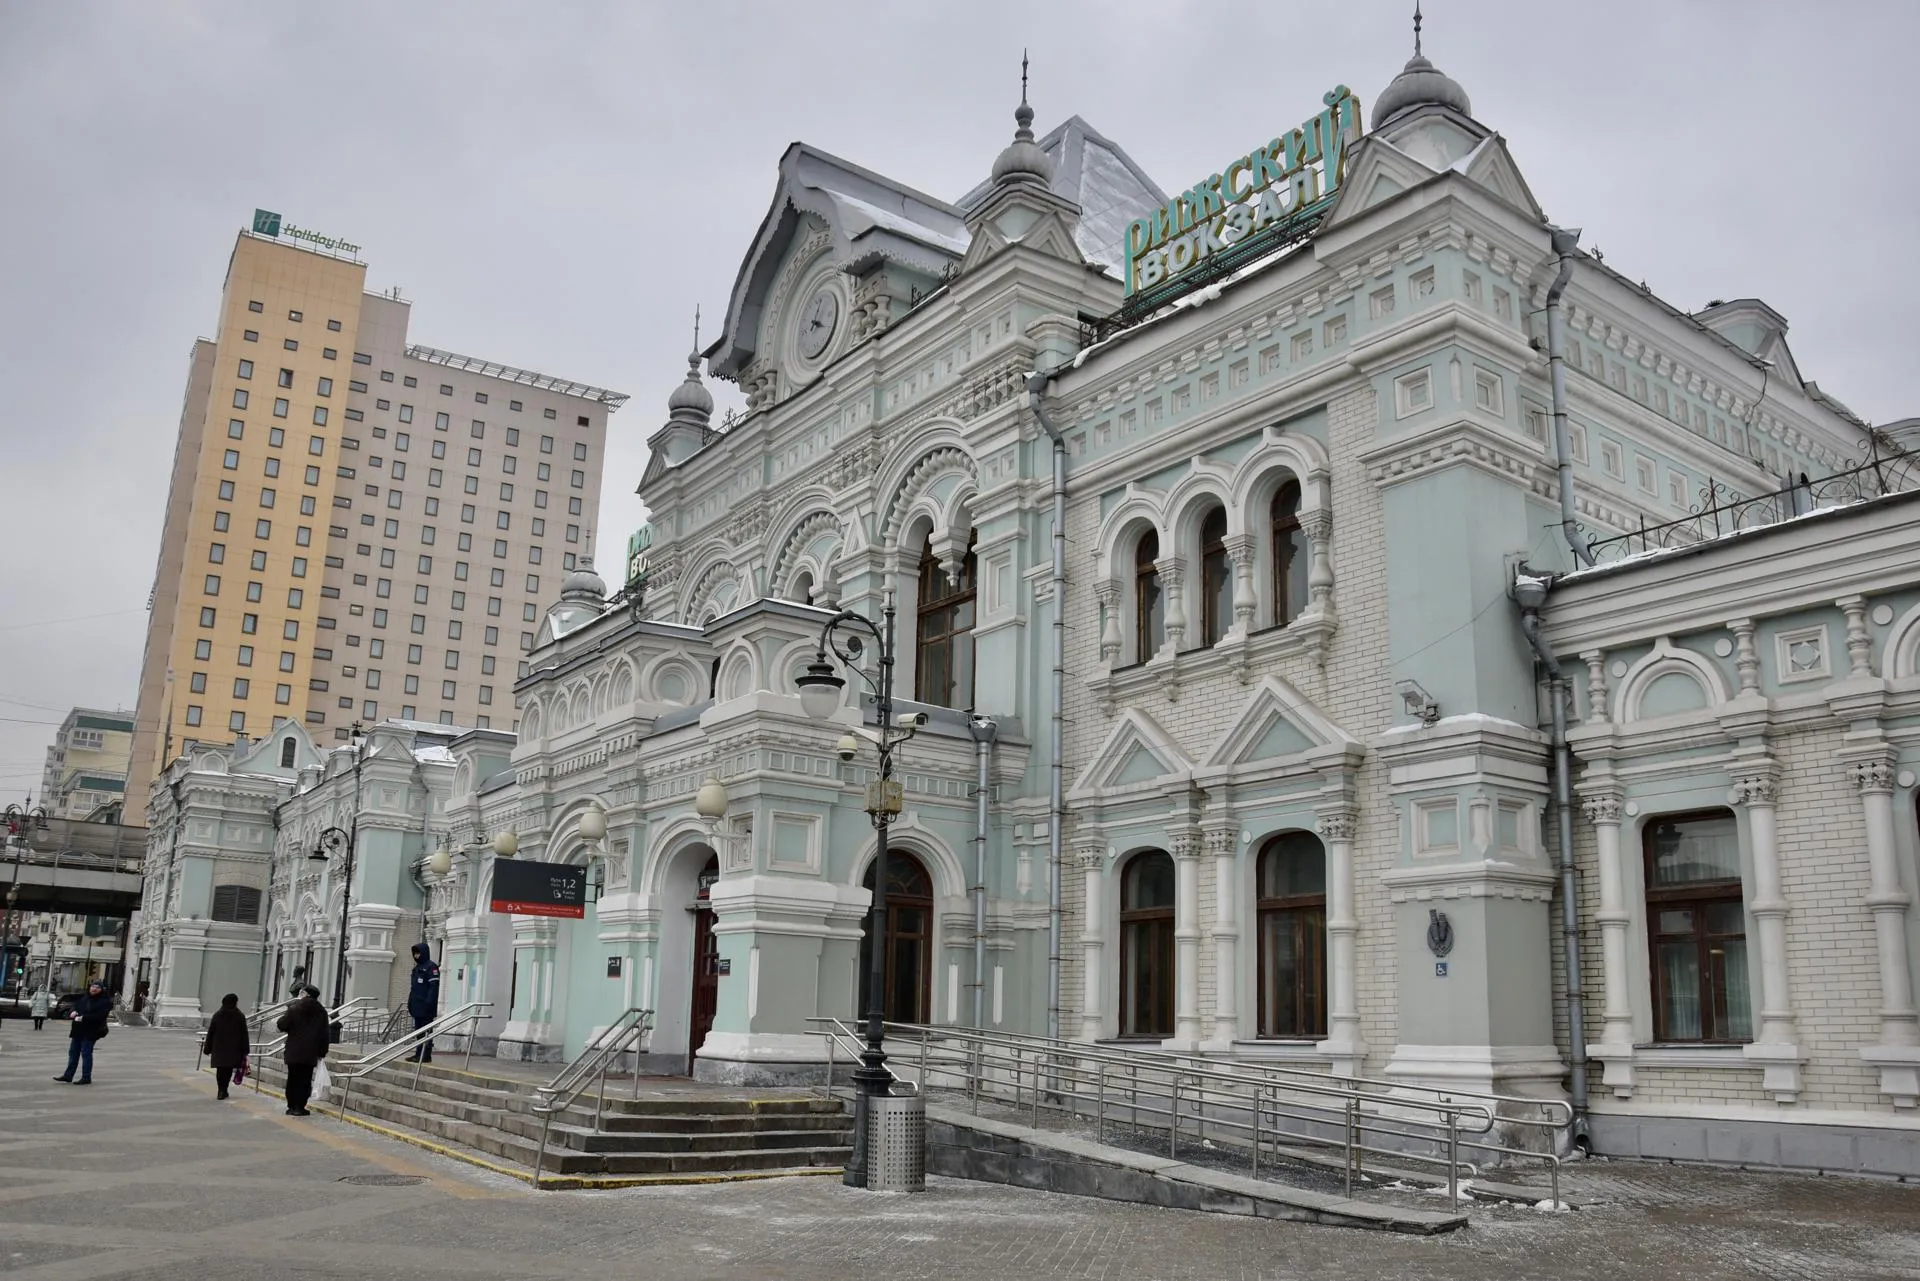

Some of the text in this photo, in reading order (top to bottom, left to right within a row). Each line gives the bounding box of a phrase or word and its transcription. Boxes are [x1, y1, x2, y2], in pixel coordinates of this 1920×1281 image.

[1123, 84, 1362, 297] РИЖСКИЙ
[284, 223, 358, 253] Holiday Inn
[1141, 167, 1319, 289] ВОКЗАЛ
[630, 557, 651, 580] ВО
[562, 878, 576, 889] 1,2
